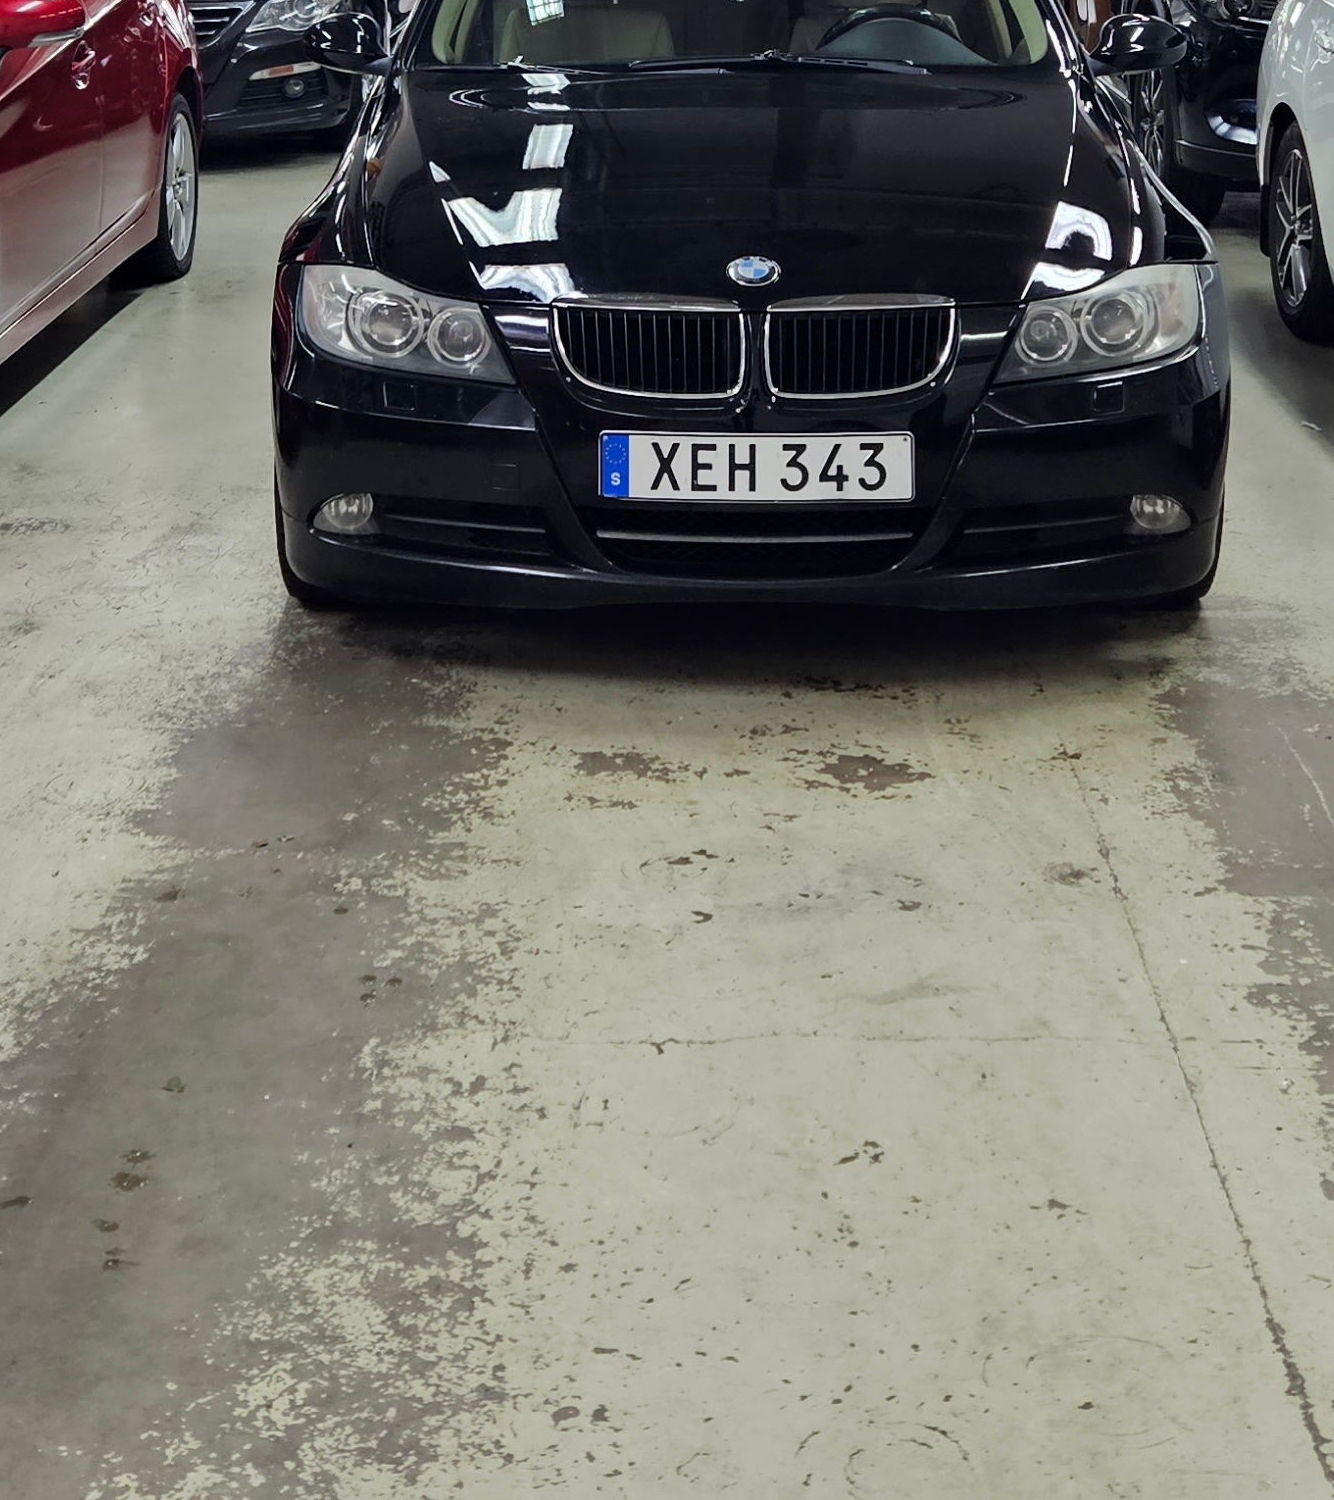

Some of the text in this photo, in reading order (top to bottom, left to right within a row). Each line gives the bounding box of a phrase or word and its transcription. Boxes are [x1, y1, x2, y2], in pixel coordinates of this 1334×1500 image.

[610, 442, 887, 492] S XEH 343
